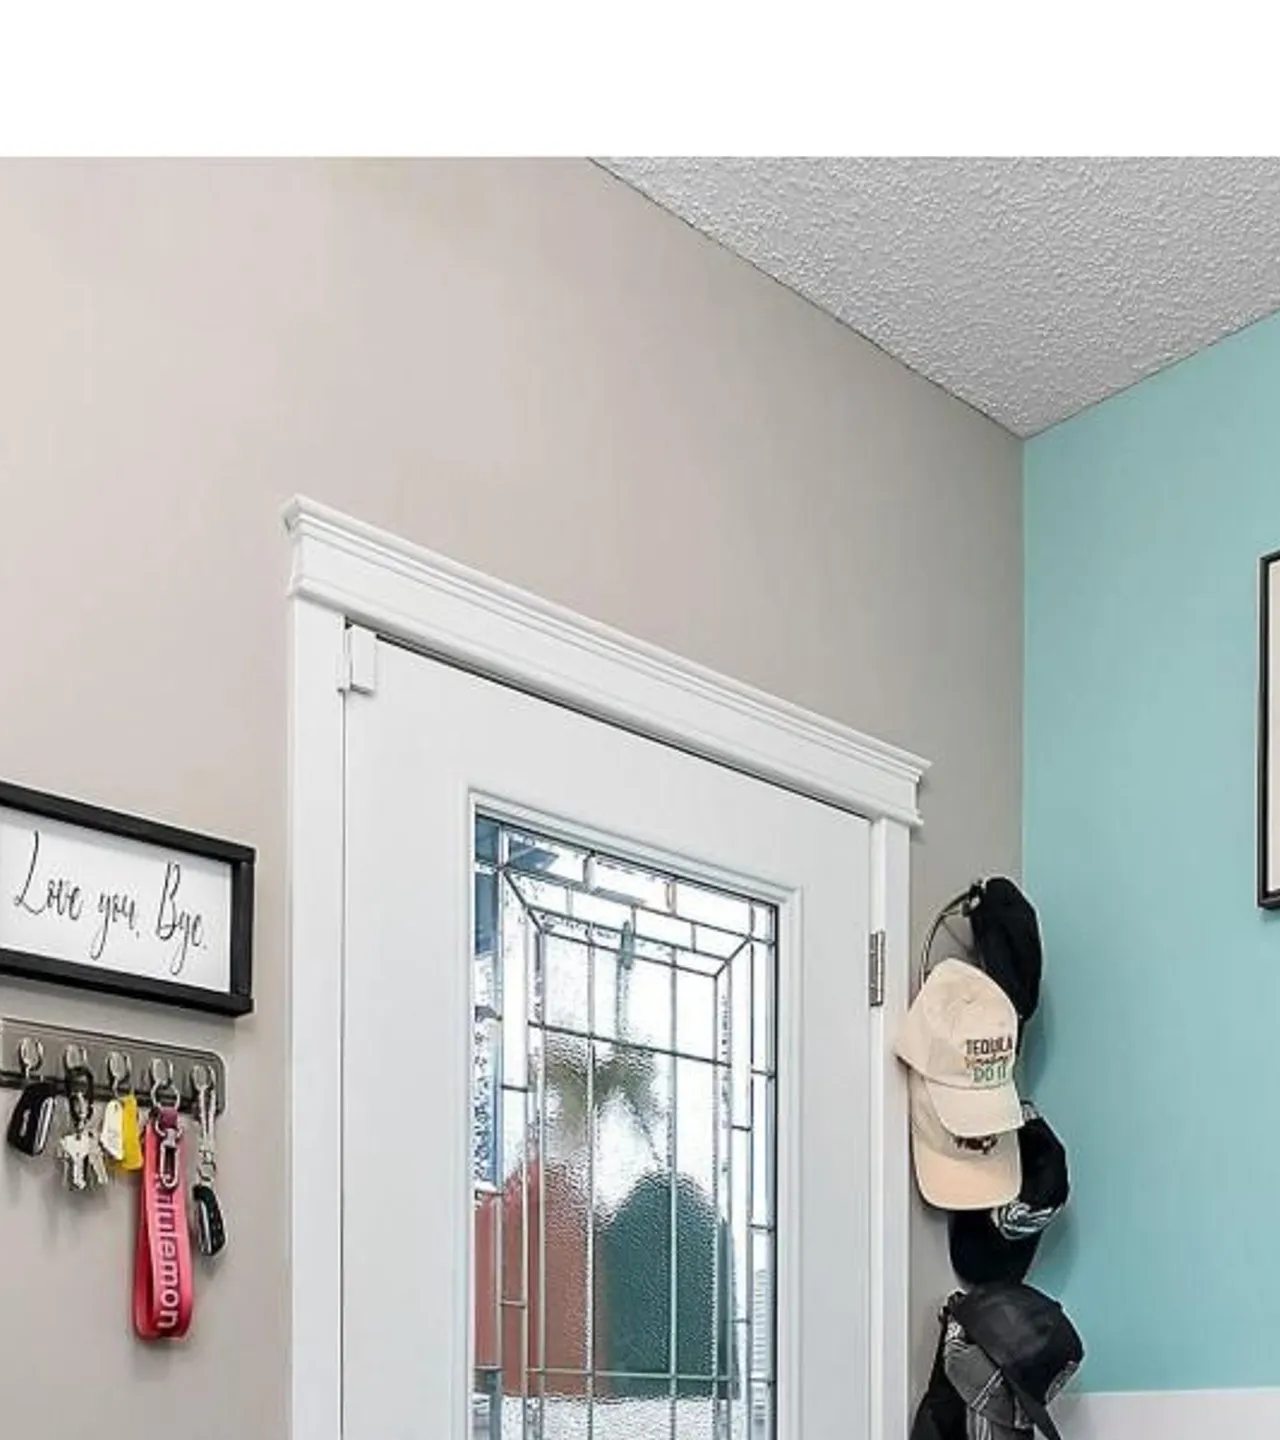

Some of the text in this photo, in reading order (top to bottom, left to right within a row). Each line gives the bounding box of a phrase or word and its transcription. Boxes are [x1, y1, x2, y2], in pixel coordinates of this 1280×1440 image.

[13, 829, 84, 921] Love
[966, 1035, 1013, 1055] TEQUILA
[154, 1174, 181, 1329] ululemon
